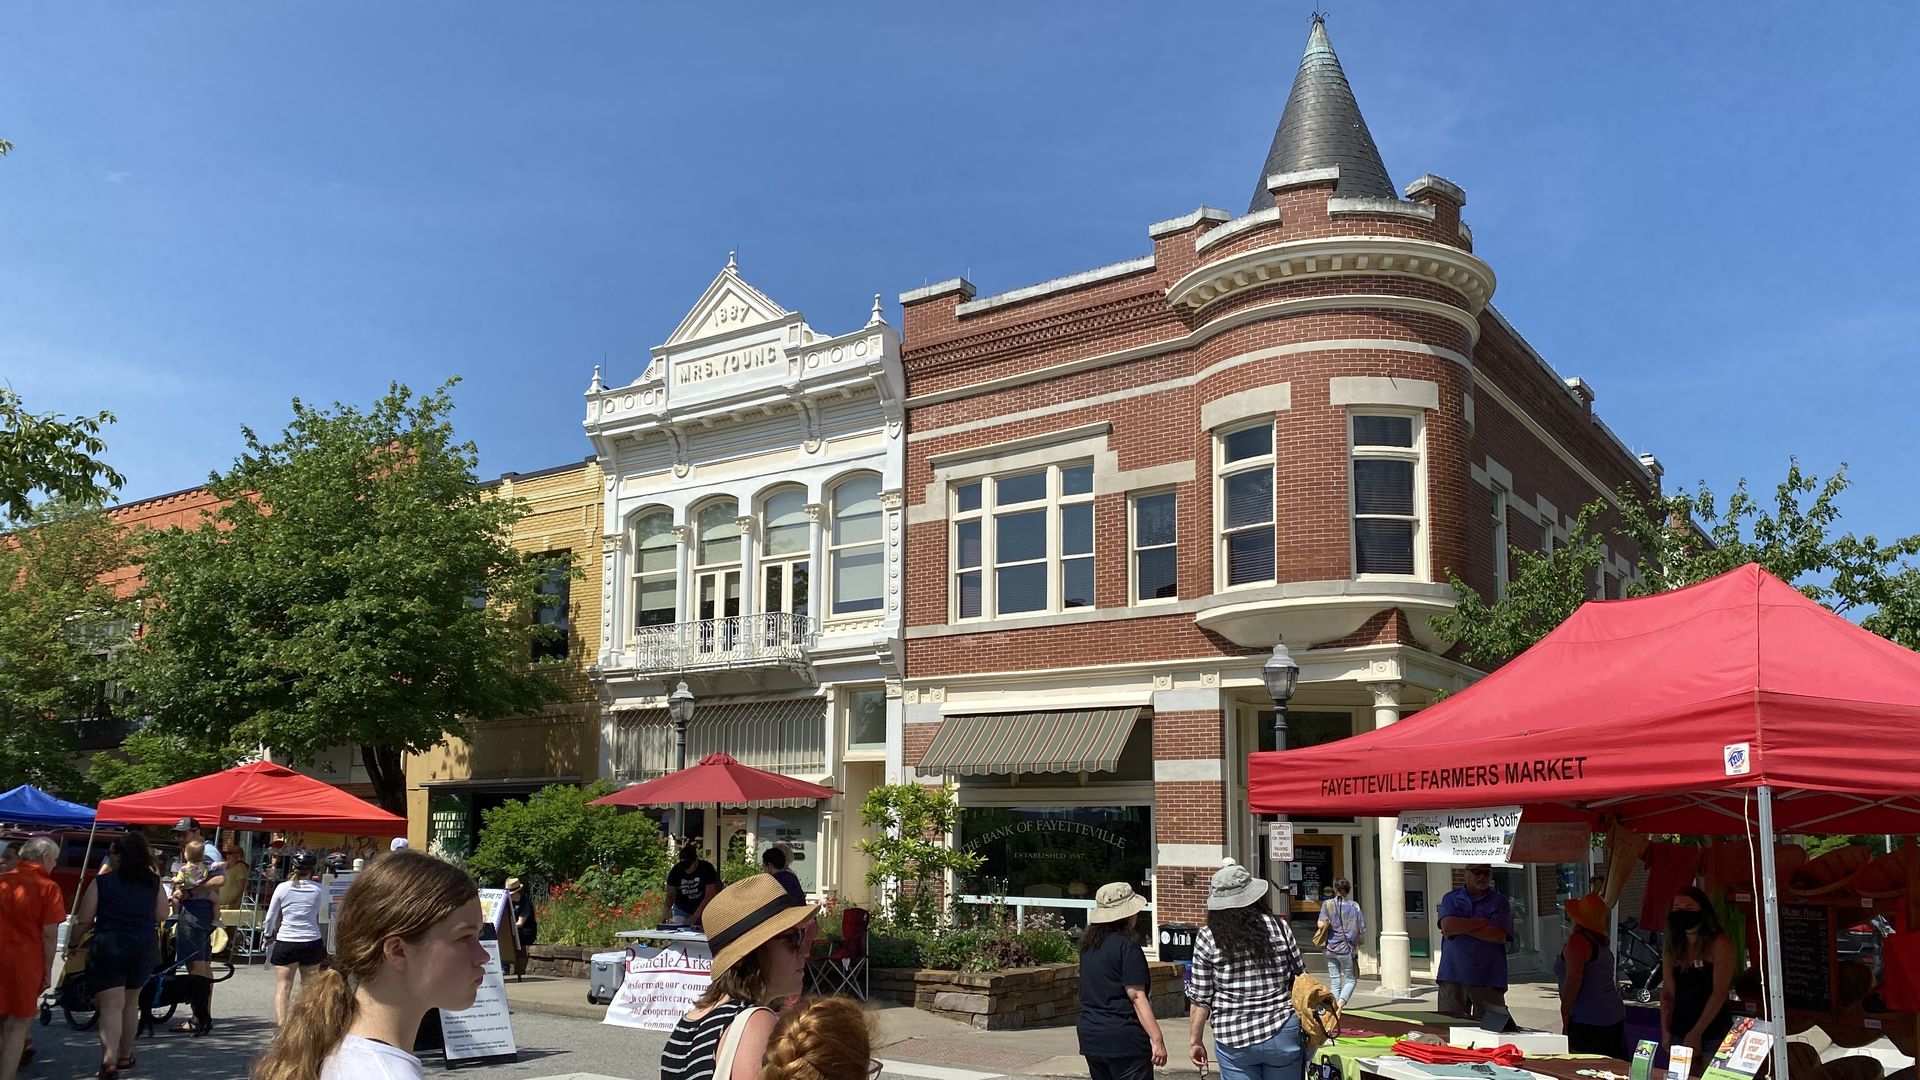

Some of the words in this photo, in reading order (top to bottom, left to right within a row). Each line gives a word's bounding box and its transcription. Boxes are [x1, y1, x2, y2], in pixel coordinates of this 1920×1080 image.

[711, 305, 751, 327] 1887
[1321, 771, 1416, 797] FAYETTEVILLE
[1420, 764, 1499, 790] FARMERS
[1505, 756, 1587, 784] MARKET
[1403, 815, 1439, 823] FAYETTEVILLE
[1447, 814, 1490, 832] Manager's
[1493, 812, 1519, 828] Booth
[960, 837, 981, 853] THE
[982, 824, 1014, 845] BANK
[1016, 820, 1034, 833] OF
[1036, 819, 1127, 849] FAYETTEVILLE
[1403, 837, 1438, 848] MARKET
[1450, 835, 1459, 843] EBT
[1459, 834, 1486, 844] Processed
[1487, 835, 1500, 844] Here
[1452, 847, 1487, 856] Transacciones
[1487, 847, 1494, 856] de
[674, 946, 712, 971] Arka
